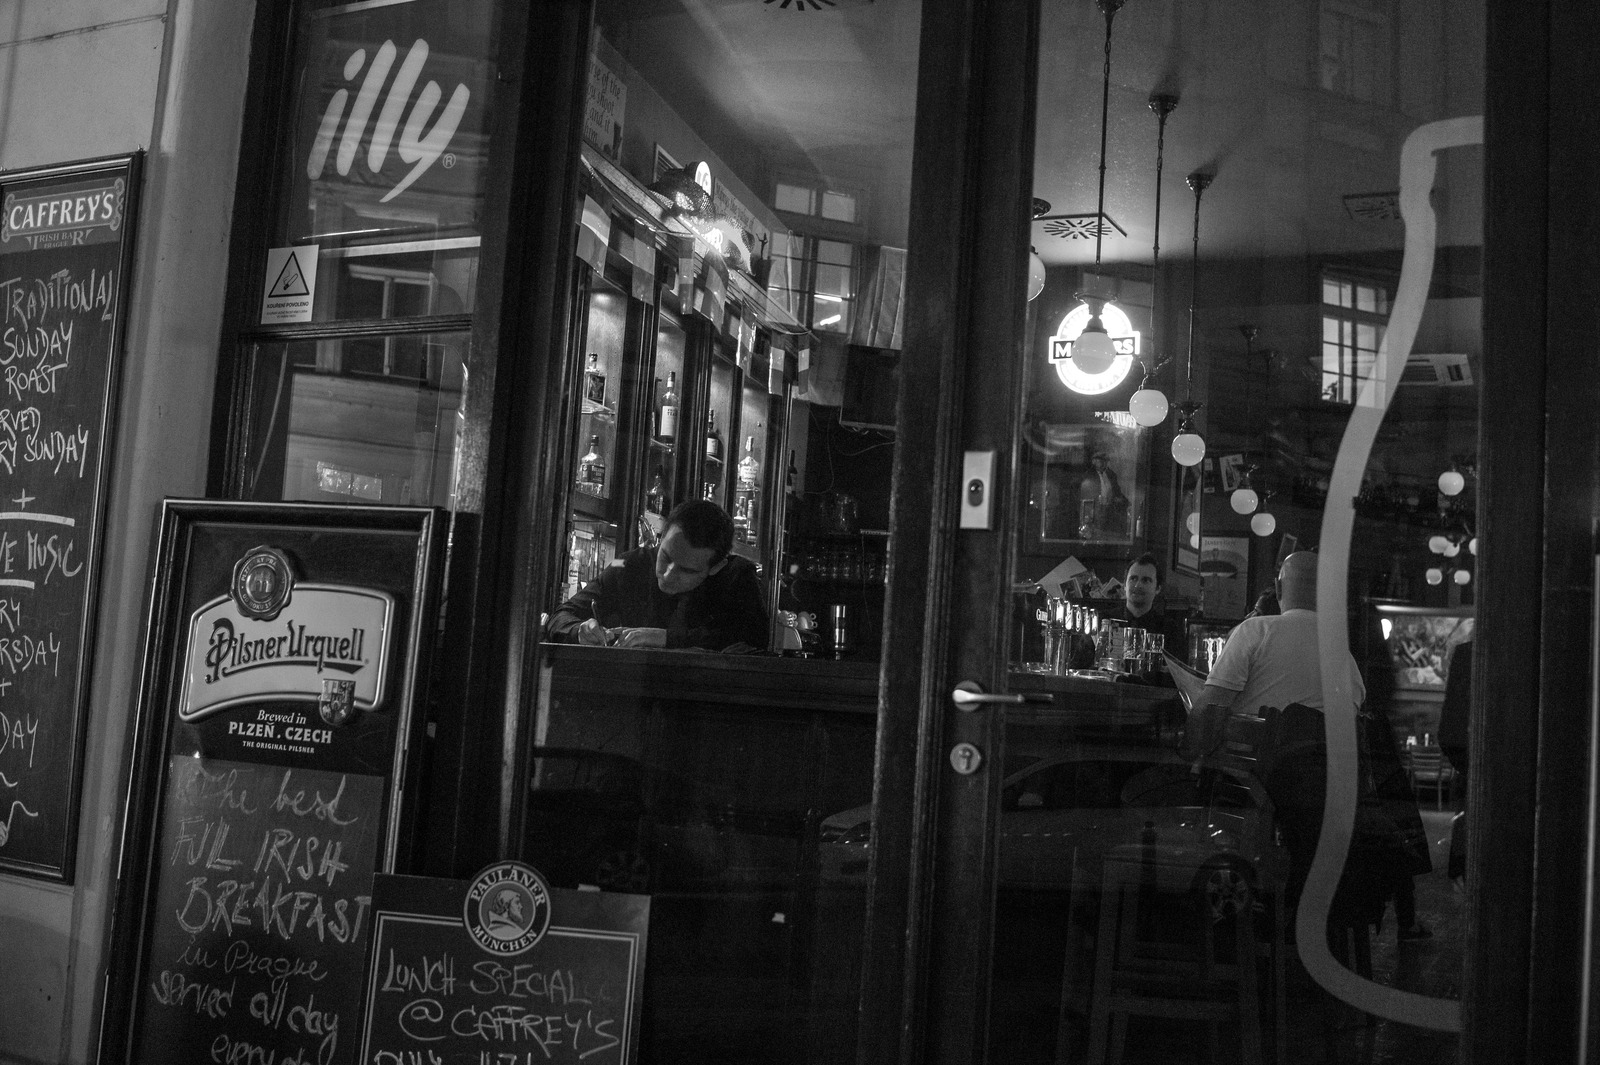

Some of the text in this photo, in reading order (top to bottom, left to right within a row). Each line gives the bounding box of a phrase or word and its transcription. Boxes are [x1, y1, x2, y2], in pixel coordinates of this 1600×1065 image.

[306, 38, 471, 203] illy
[9, 190, 115, 231] CAFFREY'S
[0, 320, 73, 369] SUNDAY
[5, 363, 68, 401] ROAST
[0, 406, 41, 447] RVED
[24, 423, 89, 479] SUNDAY
[27, 530, 83, 586] MUSIC
[0, 631, 61, 678] RSDAY
[205, 617, 365, 684] Pilsner Urquell
[228, 721, 333, 744] PLZEŇ CZECH
[257, 709, 307, 725] Brewed in
[242, 741, 315, 754] THE ORIGINAL PILSNER
[270, 769, 359, 825] best
[254, 828, 349, 887] IRISH
[176, 876, 372, 943] BREAKFAST
[470, 865, 546, 907] PAULANER
[177, 936, 328, 993] in Prague
[381, 948, 592, 1005] LUNCH SPECIAL
[250, 982, 289, 1030] all
[287, 994, 338, 1065] day
[399, 998, 447, 1041] @
